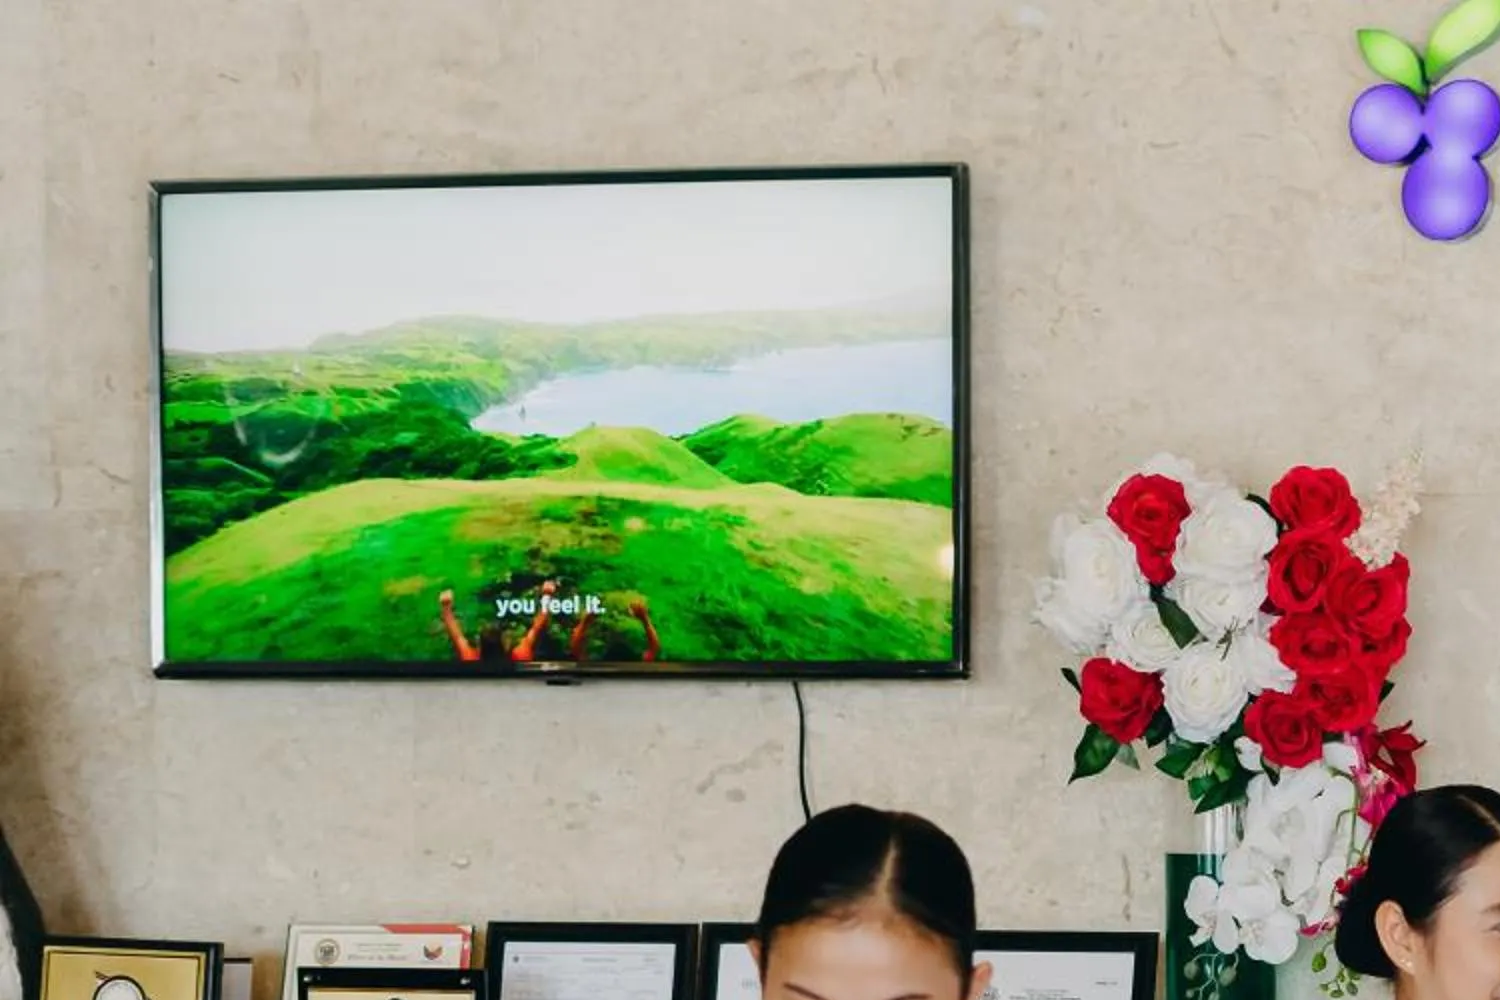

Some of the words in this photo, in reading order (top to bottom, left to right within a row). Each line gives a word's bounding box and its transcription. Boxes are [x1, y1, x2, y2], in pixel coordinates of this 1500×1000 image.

[496, 598, 536, 618] you
[541, 594, 580, 614] feel
[585, 594, 607, 614] it.
